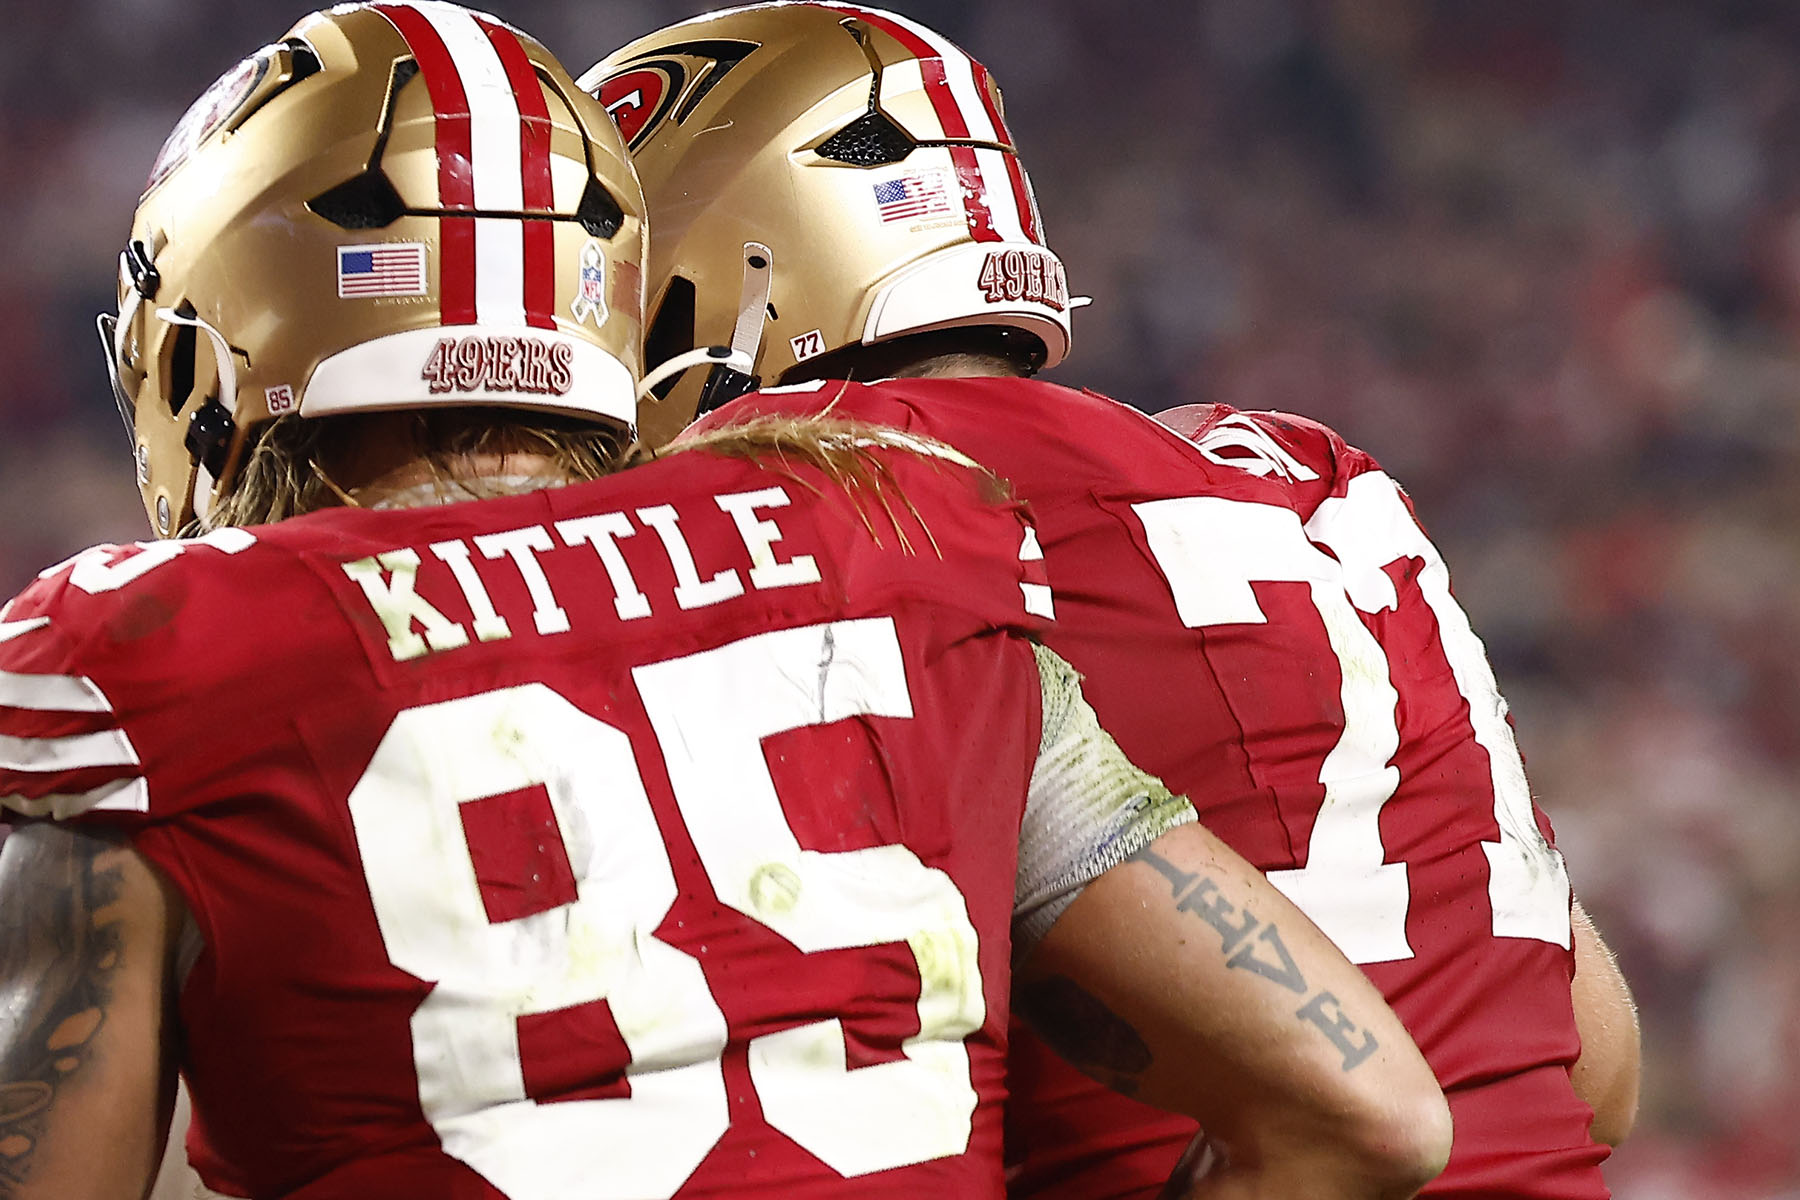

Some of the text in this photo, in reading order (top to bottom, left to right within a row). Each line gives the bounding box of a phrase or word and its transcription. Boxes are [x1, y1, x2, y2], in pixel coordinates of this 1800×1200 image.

[978, 249, 1068, 312] 49ERS
[421, 335, 574, 396] 49ERS
[794, 332, 819, 358] 77
[267, 388, 291, 412] 85
[342, 486, 823, 662] KITTLE
[1131, 466, 1571, 965] 77
